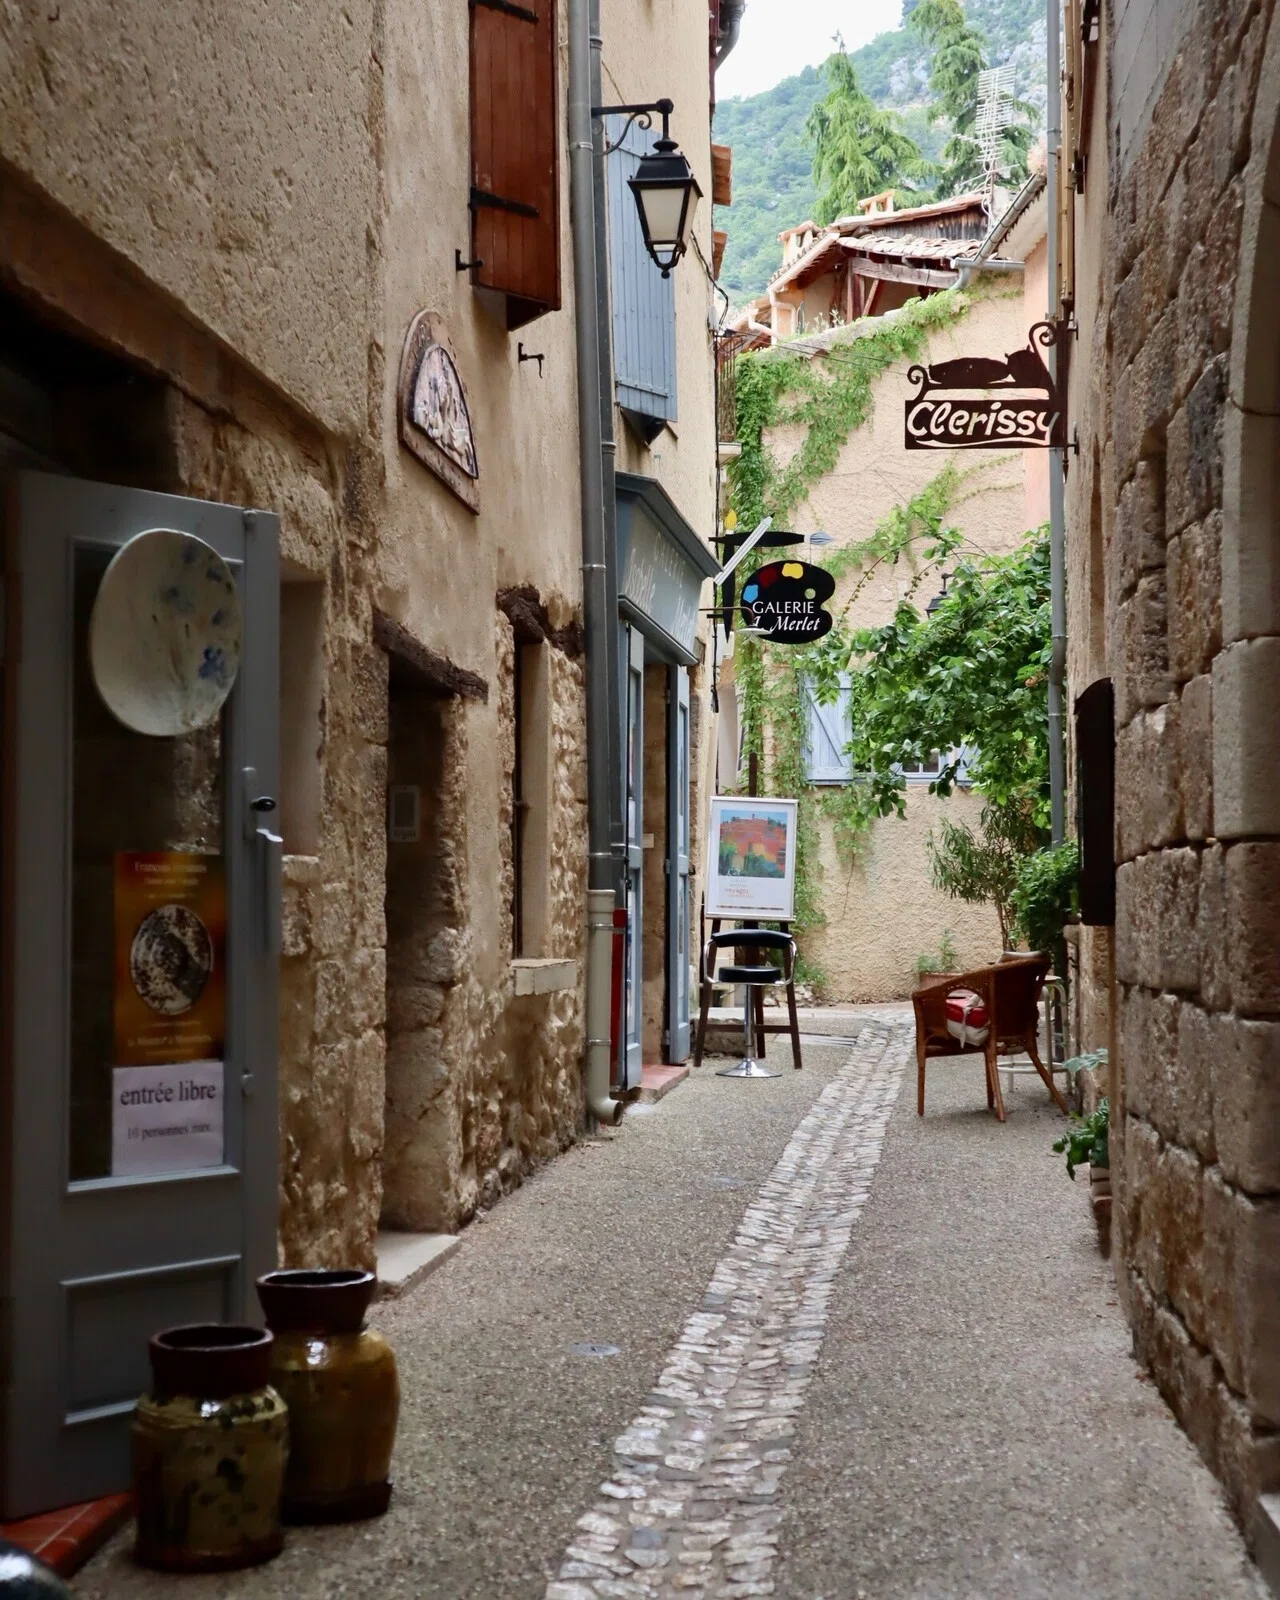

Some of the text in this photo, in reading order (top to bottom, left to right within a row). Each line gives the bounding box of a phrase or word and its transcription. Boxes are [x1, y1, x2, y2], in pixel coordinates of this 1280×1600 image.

[906, 402, 1060, 446] Clerissy
[752, 601, 815, 614] GALERIE
[769, 615, 821, 632] Merlet
[120, 1079, 216, 1106] entrée libre
